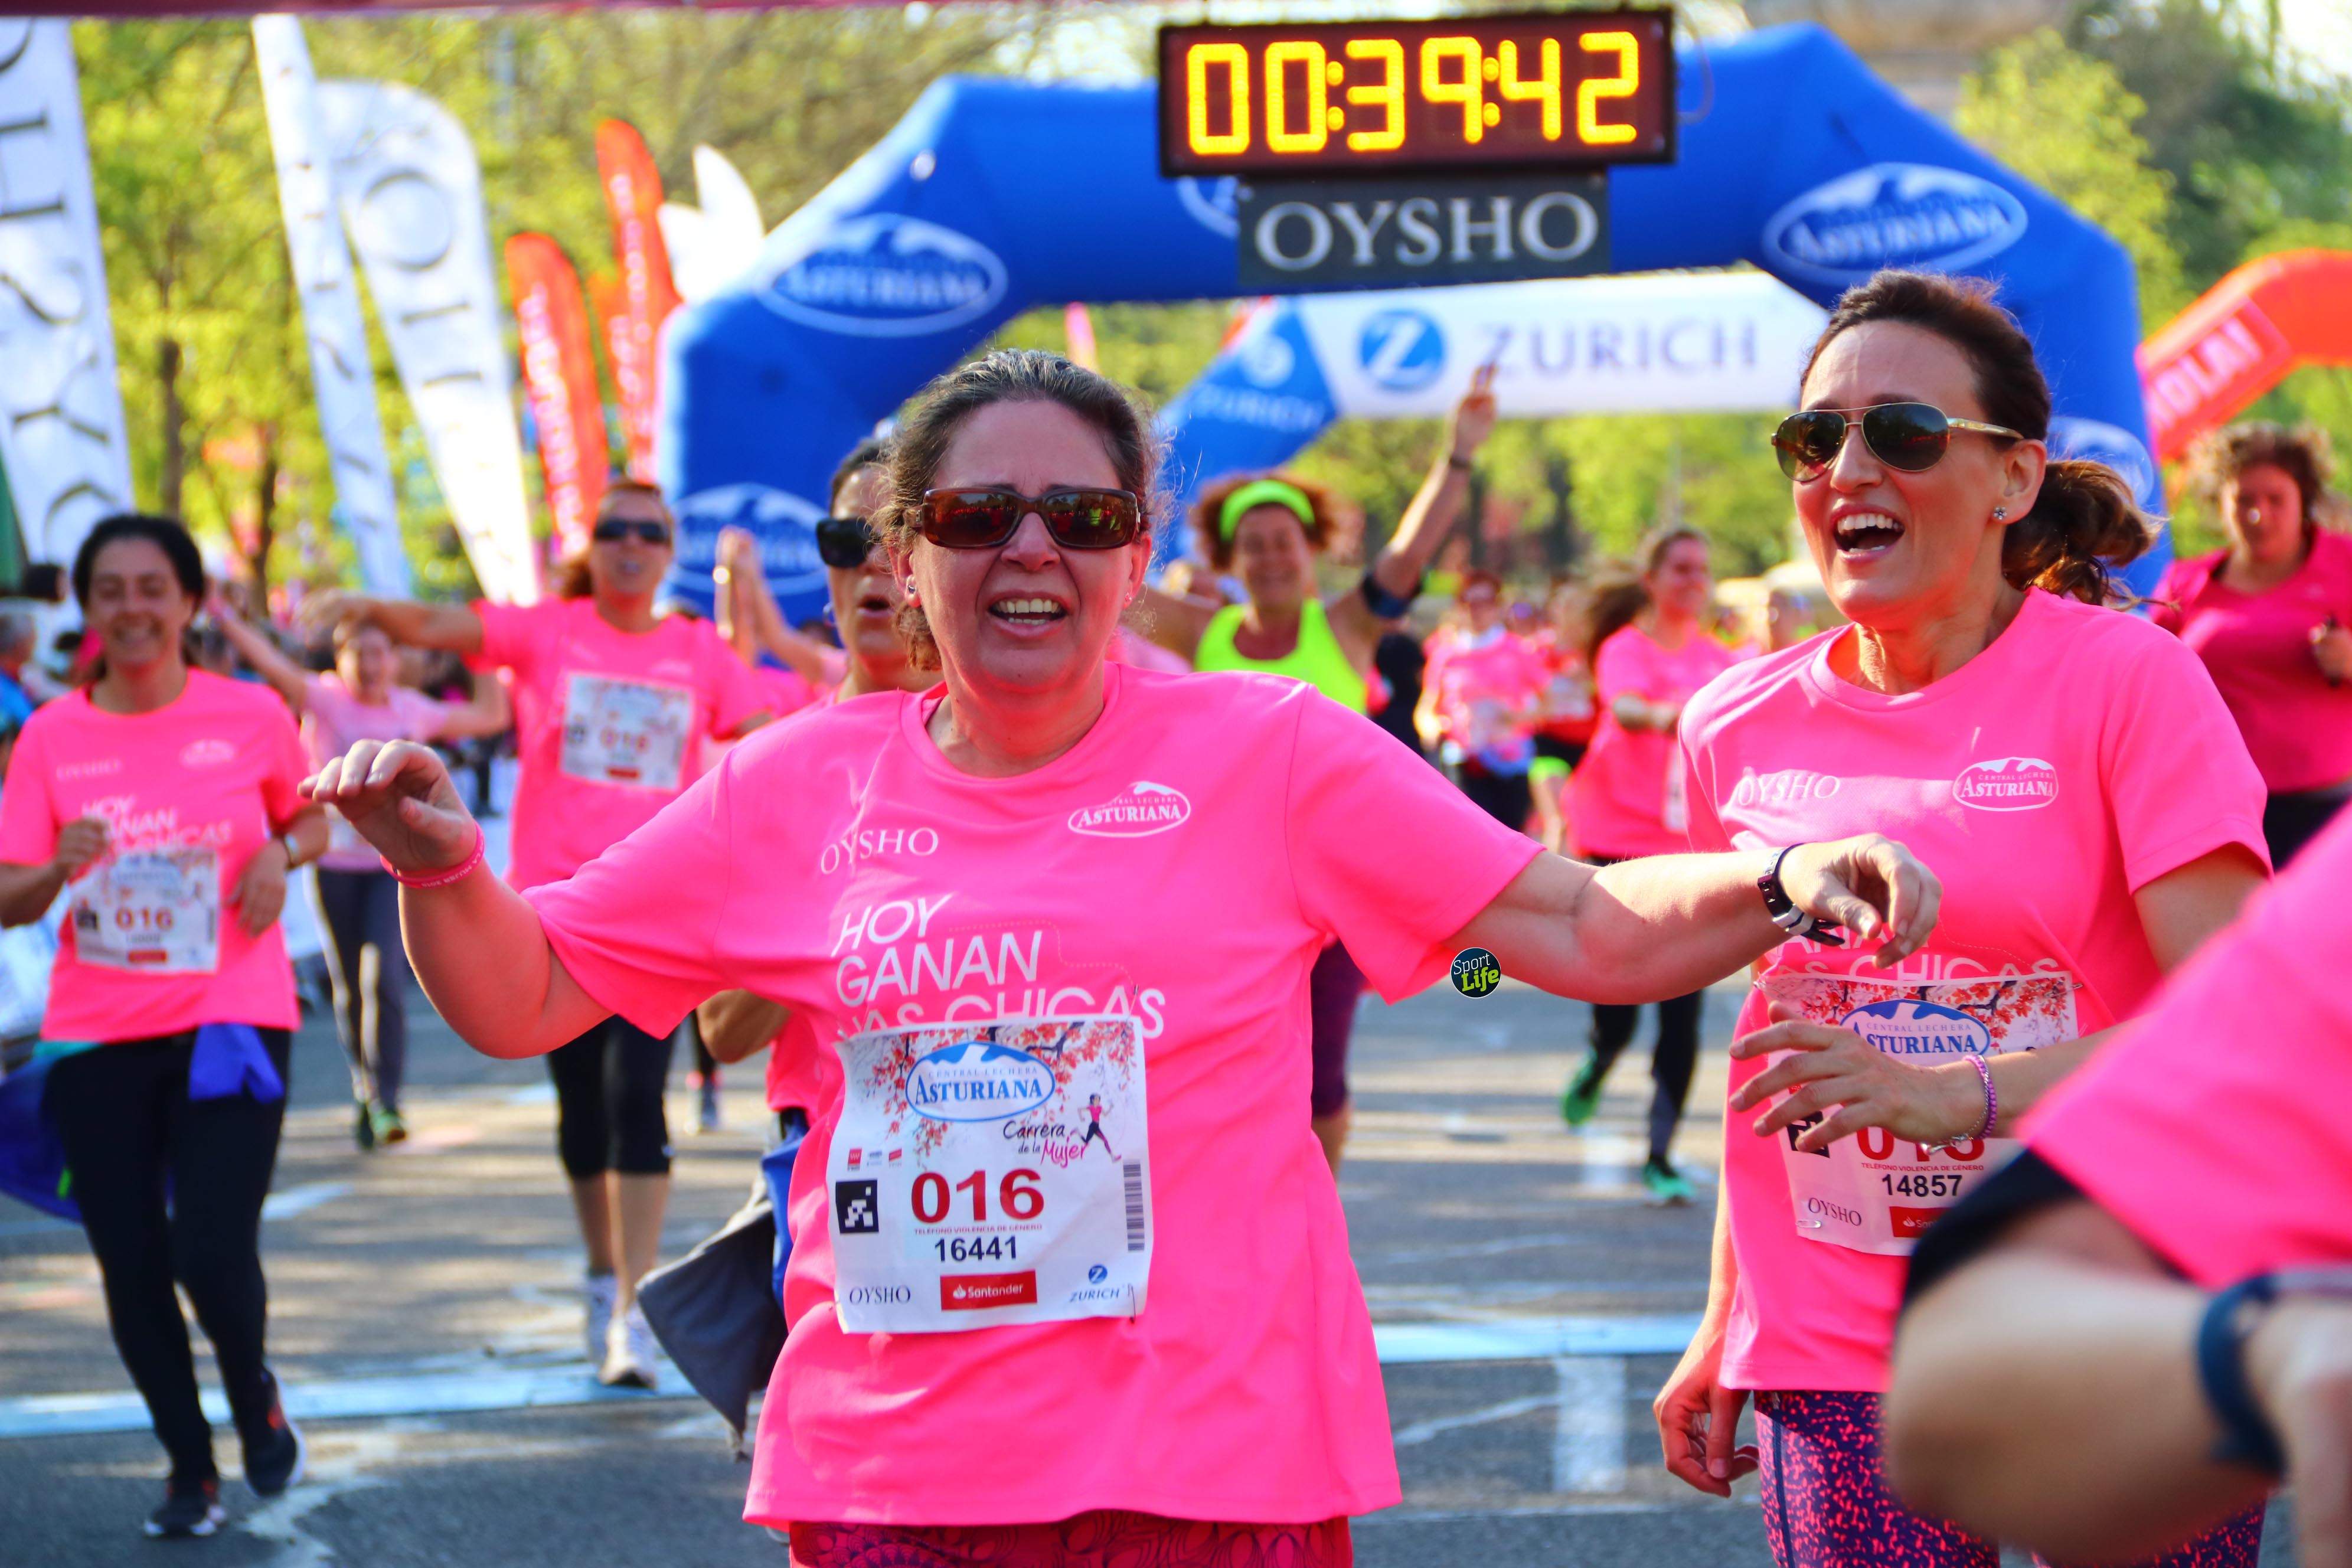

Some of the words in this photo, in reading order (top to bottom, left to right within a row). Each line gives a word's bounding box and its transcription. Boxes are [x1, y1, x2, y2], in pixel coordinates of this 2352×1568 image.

[1255, 192, 1599, 272] OYSHO
[1479, 319, 1759, 376] ZURICH
[1138, 796, 1177, 804] LECHERA
[1739, 775, 1841, 806] OYSHO
[1961, 776, 2054, 798] ASTURIANA
[1077, 804, 1181, 829] ASTURIANA
[820, 827, 939, 875] OYSHO
[115, 907, 174, 932] 016
[831, 893, 953, 958] HOY
[836, 930, 1043, 1007] GANAN
[1854, 1022, 1979, 1054] STURIANA
[1866, 1023, 1913, 1033] CENTRAL
[1919, 1024, 1972, 1032] LECHERA
[929, 1067, 979, 1079] CENTRAL
[985, 1066, 1038, 1077] LECHERA
[915, 1074, 1043, 1105] ASTURIANA
[1003, 1121, 1066, 1139] Carrera
[1018, 1139, 1030, 1154] de
[1032, 1139, 1041, 1153] la
[1040, 1136, 1088, 1169] Mujer
[911, 1168, 1045, 1224] 016
[1882, 1174, 1963, 1197] 14857
[1808, 1197, 1862, 1226] OYSHO
[935, 1236, 1017, 1262] 16441
[849, 1285, 911, 1305] OYSHO
[968, 1283, 1024, 1299] Santander
[1069, 1288, 1120, 1302] ZURICH
